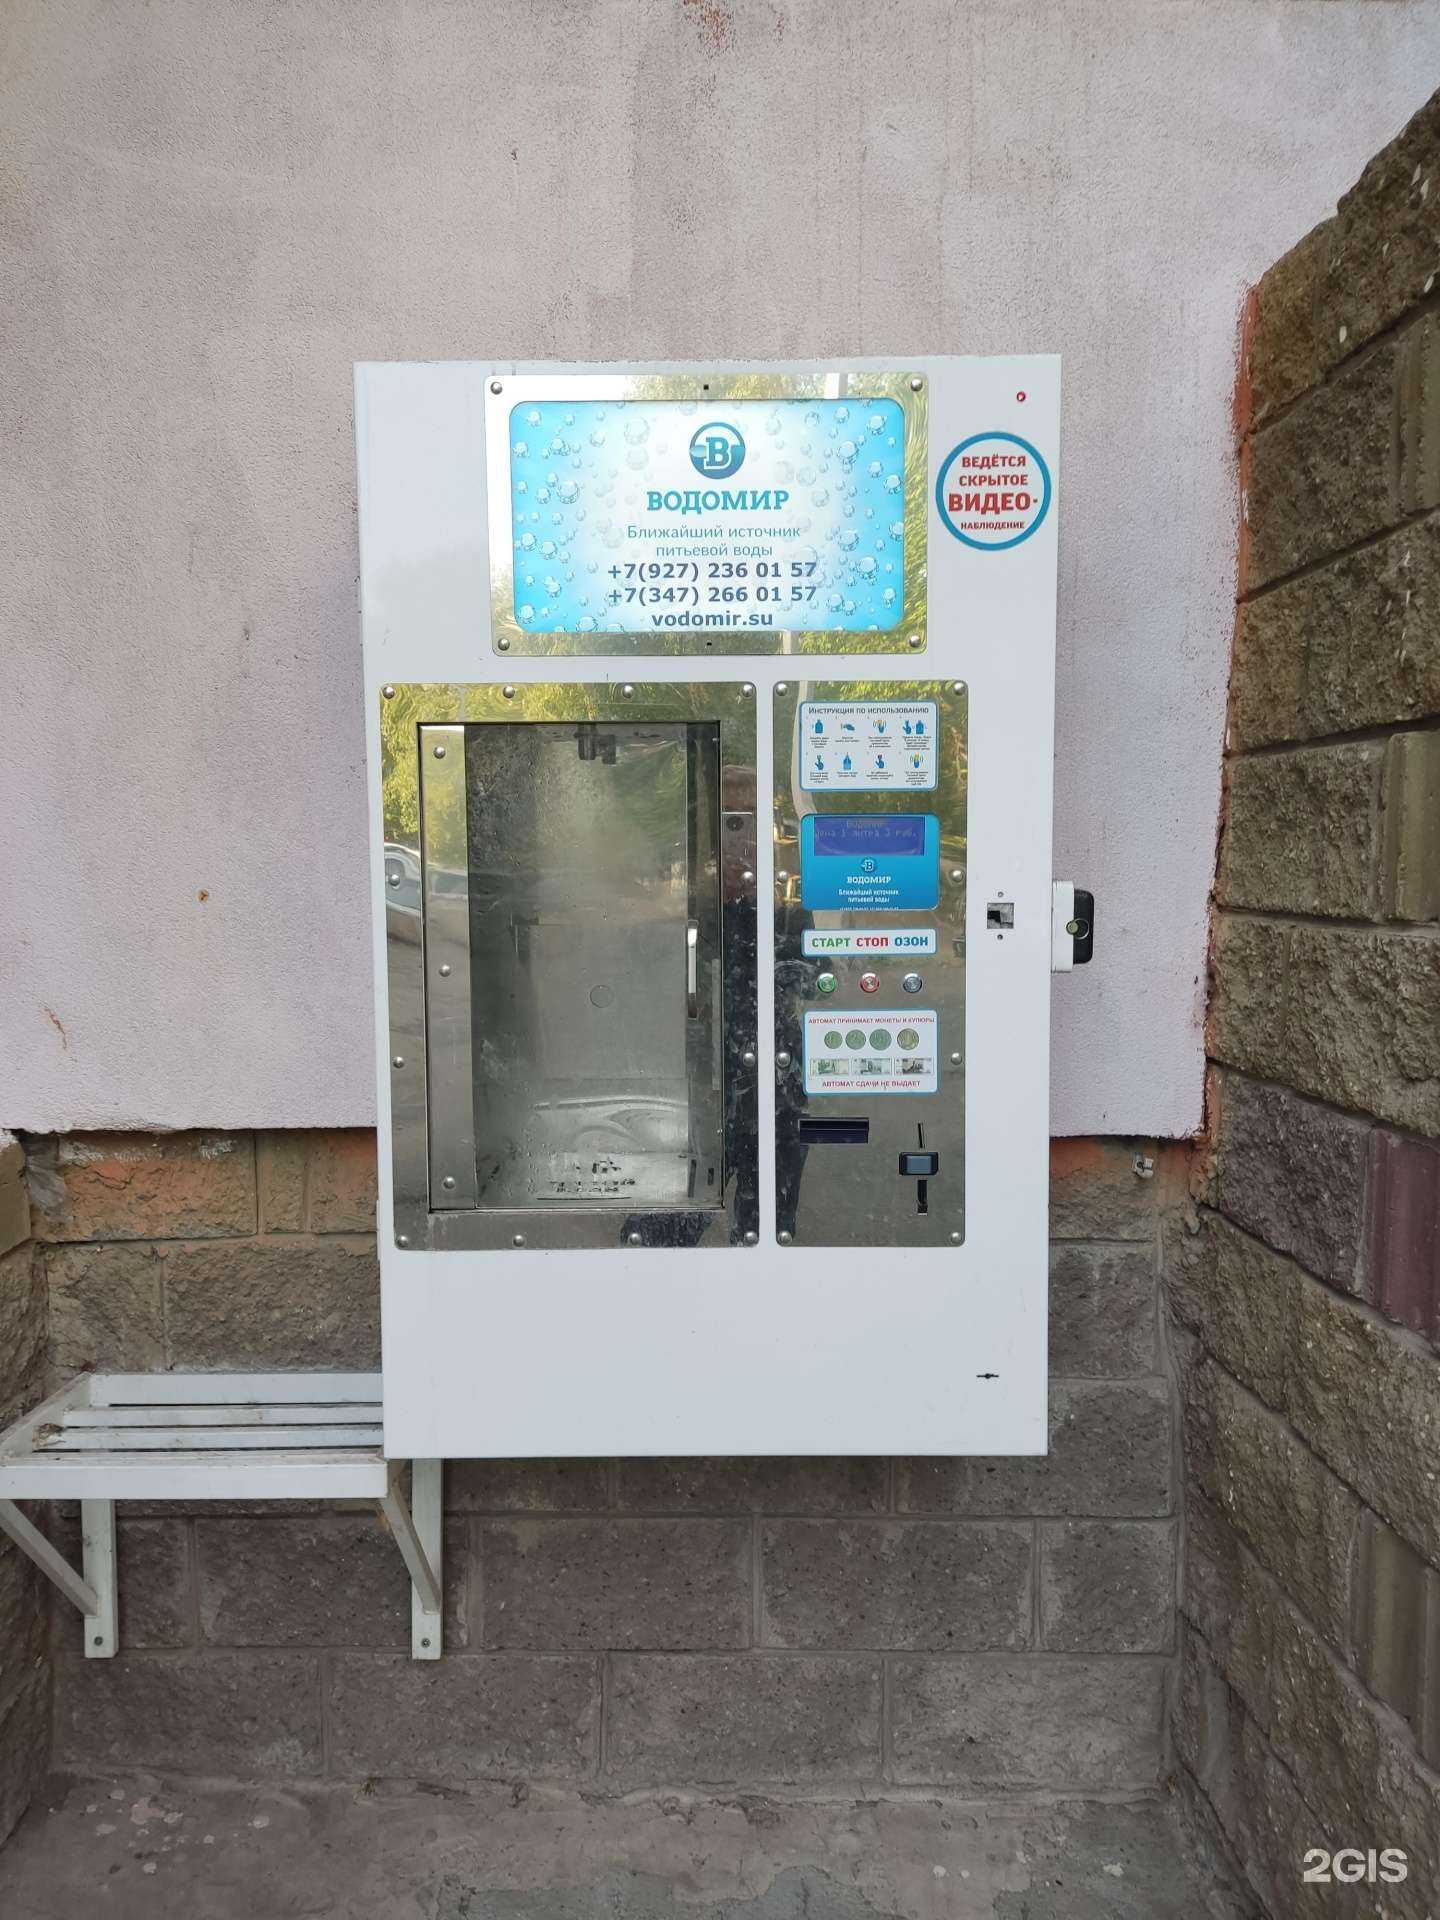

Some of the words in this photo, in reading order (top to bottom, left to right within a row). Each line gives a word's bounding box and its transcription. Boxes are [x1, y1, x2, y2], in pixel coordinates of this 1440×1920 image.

[962, 454, 1026, 469] ВЕДЁТСЯ
[959, 474, 1028, 487] СКРЫТОЕ
[647, 490, 789, 515] ВОДОМИР
[627, 525, 723, 539] Ближайший
[728, 526, 800, 538] источник
[961, 521, 1025, 531] НАБЛЮДЕНИЕ
[656, 543, 728, 557] питьевой
[733, 546, 773, 557] воды
[608, 562, 699, 582] +7(927)
[708, 562, 748, 579] 236
[756, 562, 782, 579] 01
[790, 562, 817, 579] 57
[608, 586, 699, 606] +7(347)
[708, 586, 748, 603] 266
[756, 586, 782, 603] 01
[790, 586, 817, 603] 57
[652, 611, 773, 627] vodomir.su
[847, 875, 892, 885] ВОДОМИР
[811, 937, 851, 948] СТАРТ
[856, 937, 889, 947] СТОП
[894, 936, 929, 947] ОЗОН
[891, 1080, 921, 1088] ВЫДАЕТ
